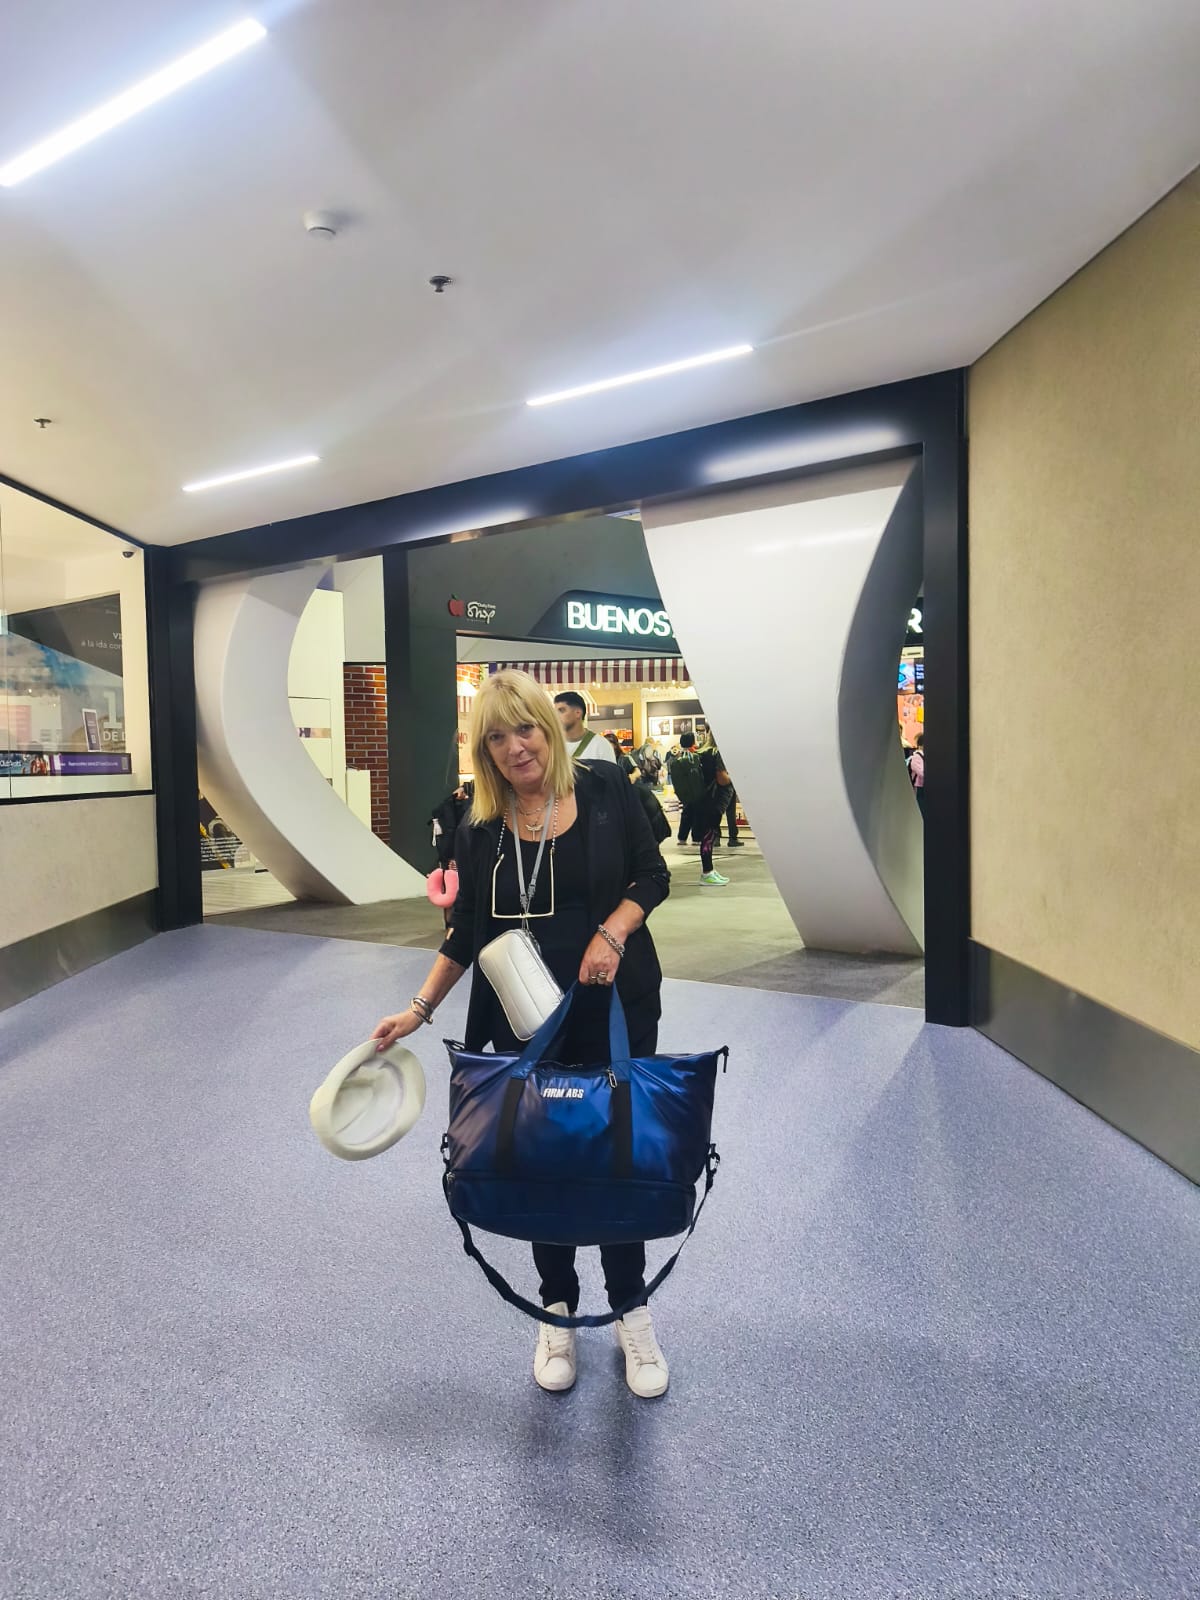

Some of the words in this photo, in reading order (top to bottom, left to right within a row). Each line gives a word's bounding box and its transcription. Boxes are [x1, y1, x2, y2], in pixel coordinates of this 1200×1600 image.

[567, 601, 671, 637] BUENOS
[103, 731, 119, 742] DE
[543, 1088, 565, 1098] FIRM
[566, 1088, 584, 1099] ABS
